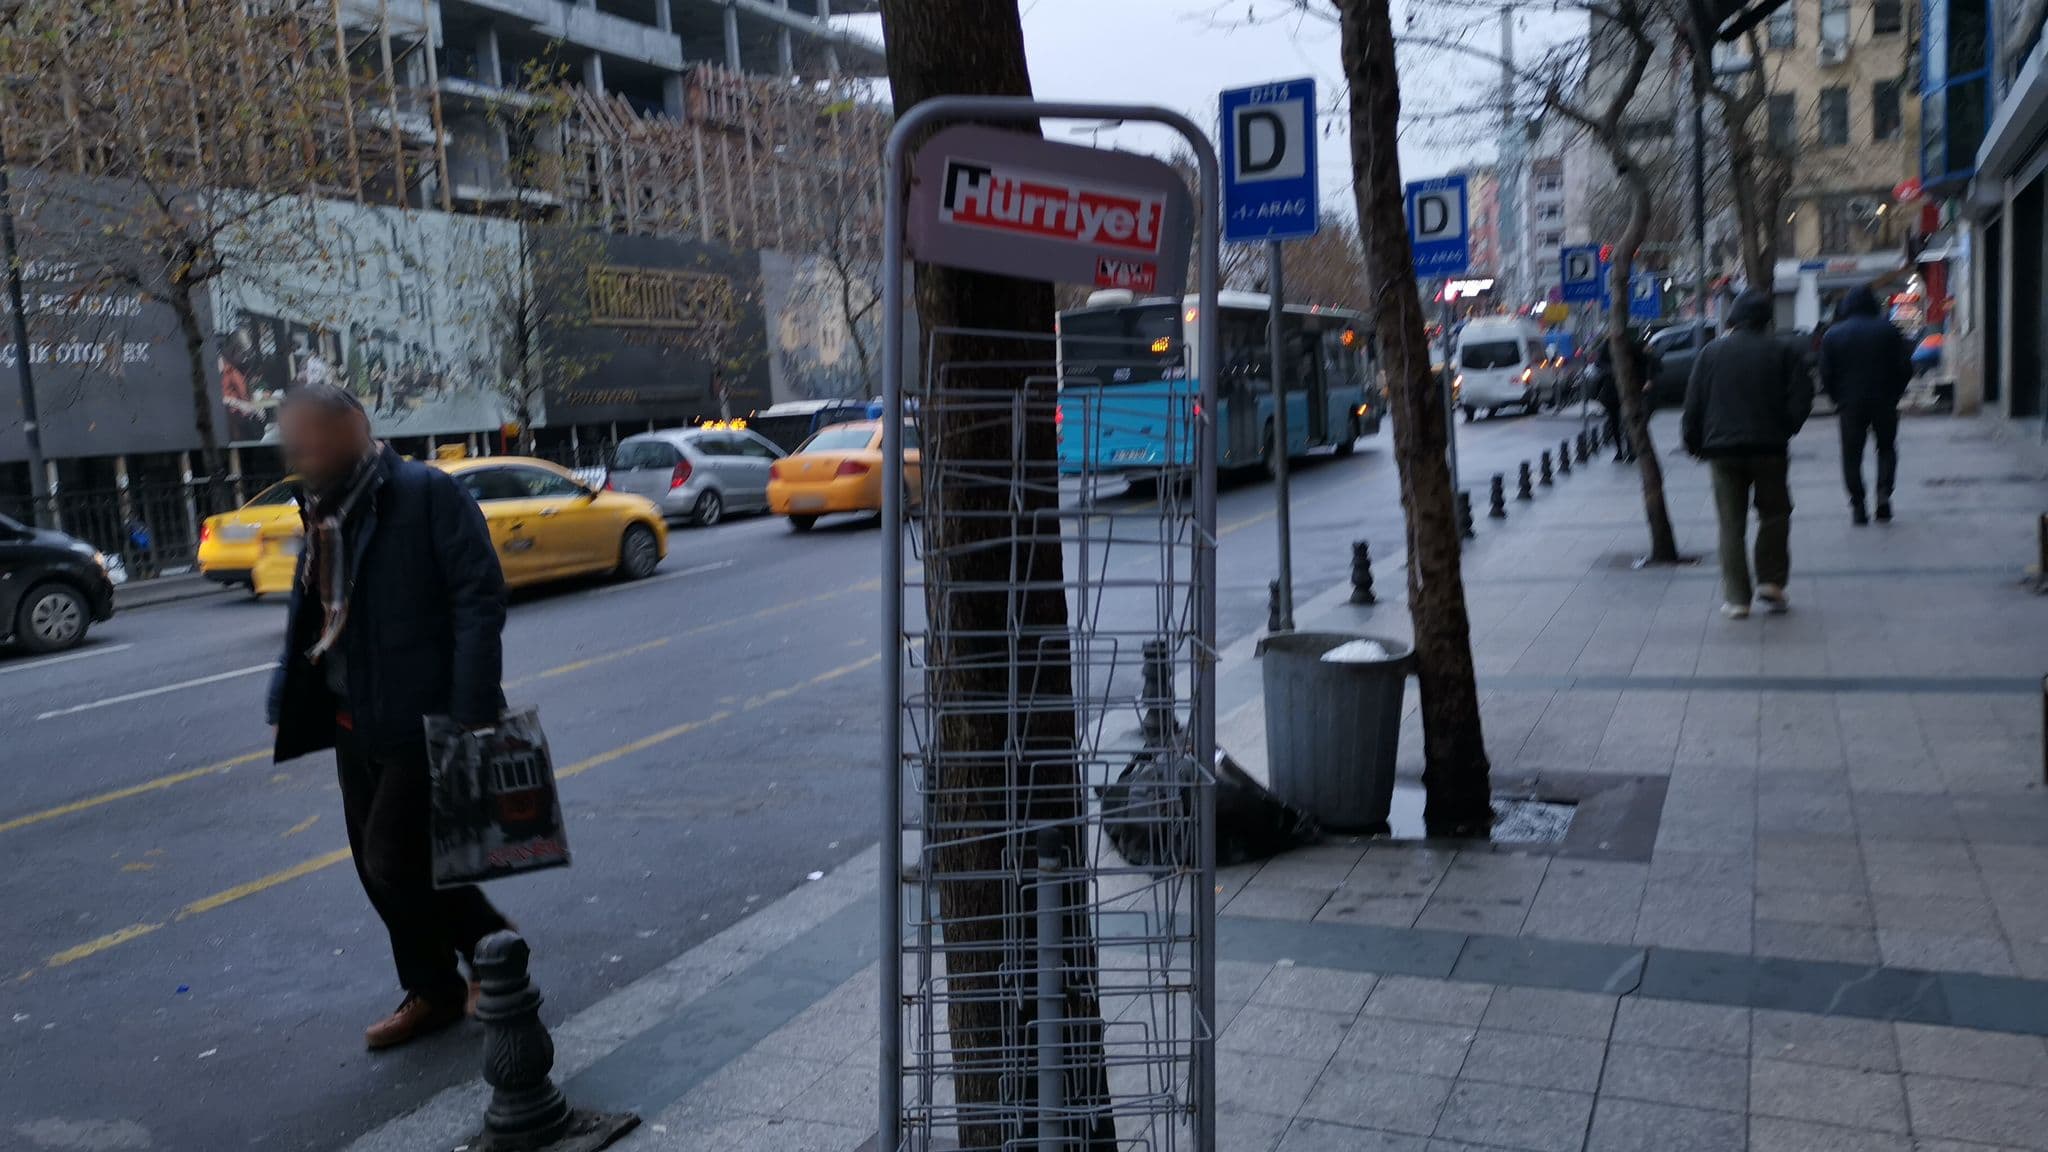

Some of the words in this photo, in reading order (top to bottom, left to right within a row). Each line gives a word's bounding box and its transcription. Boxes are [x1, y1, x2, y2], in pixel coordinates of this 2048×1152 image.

[1239, 111, 1286, 175] D
[952, 168, 1156, 243] Hürriyet
[1418, 195, 1448, 235] D
